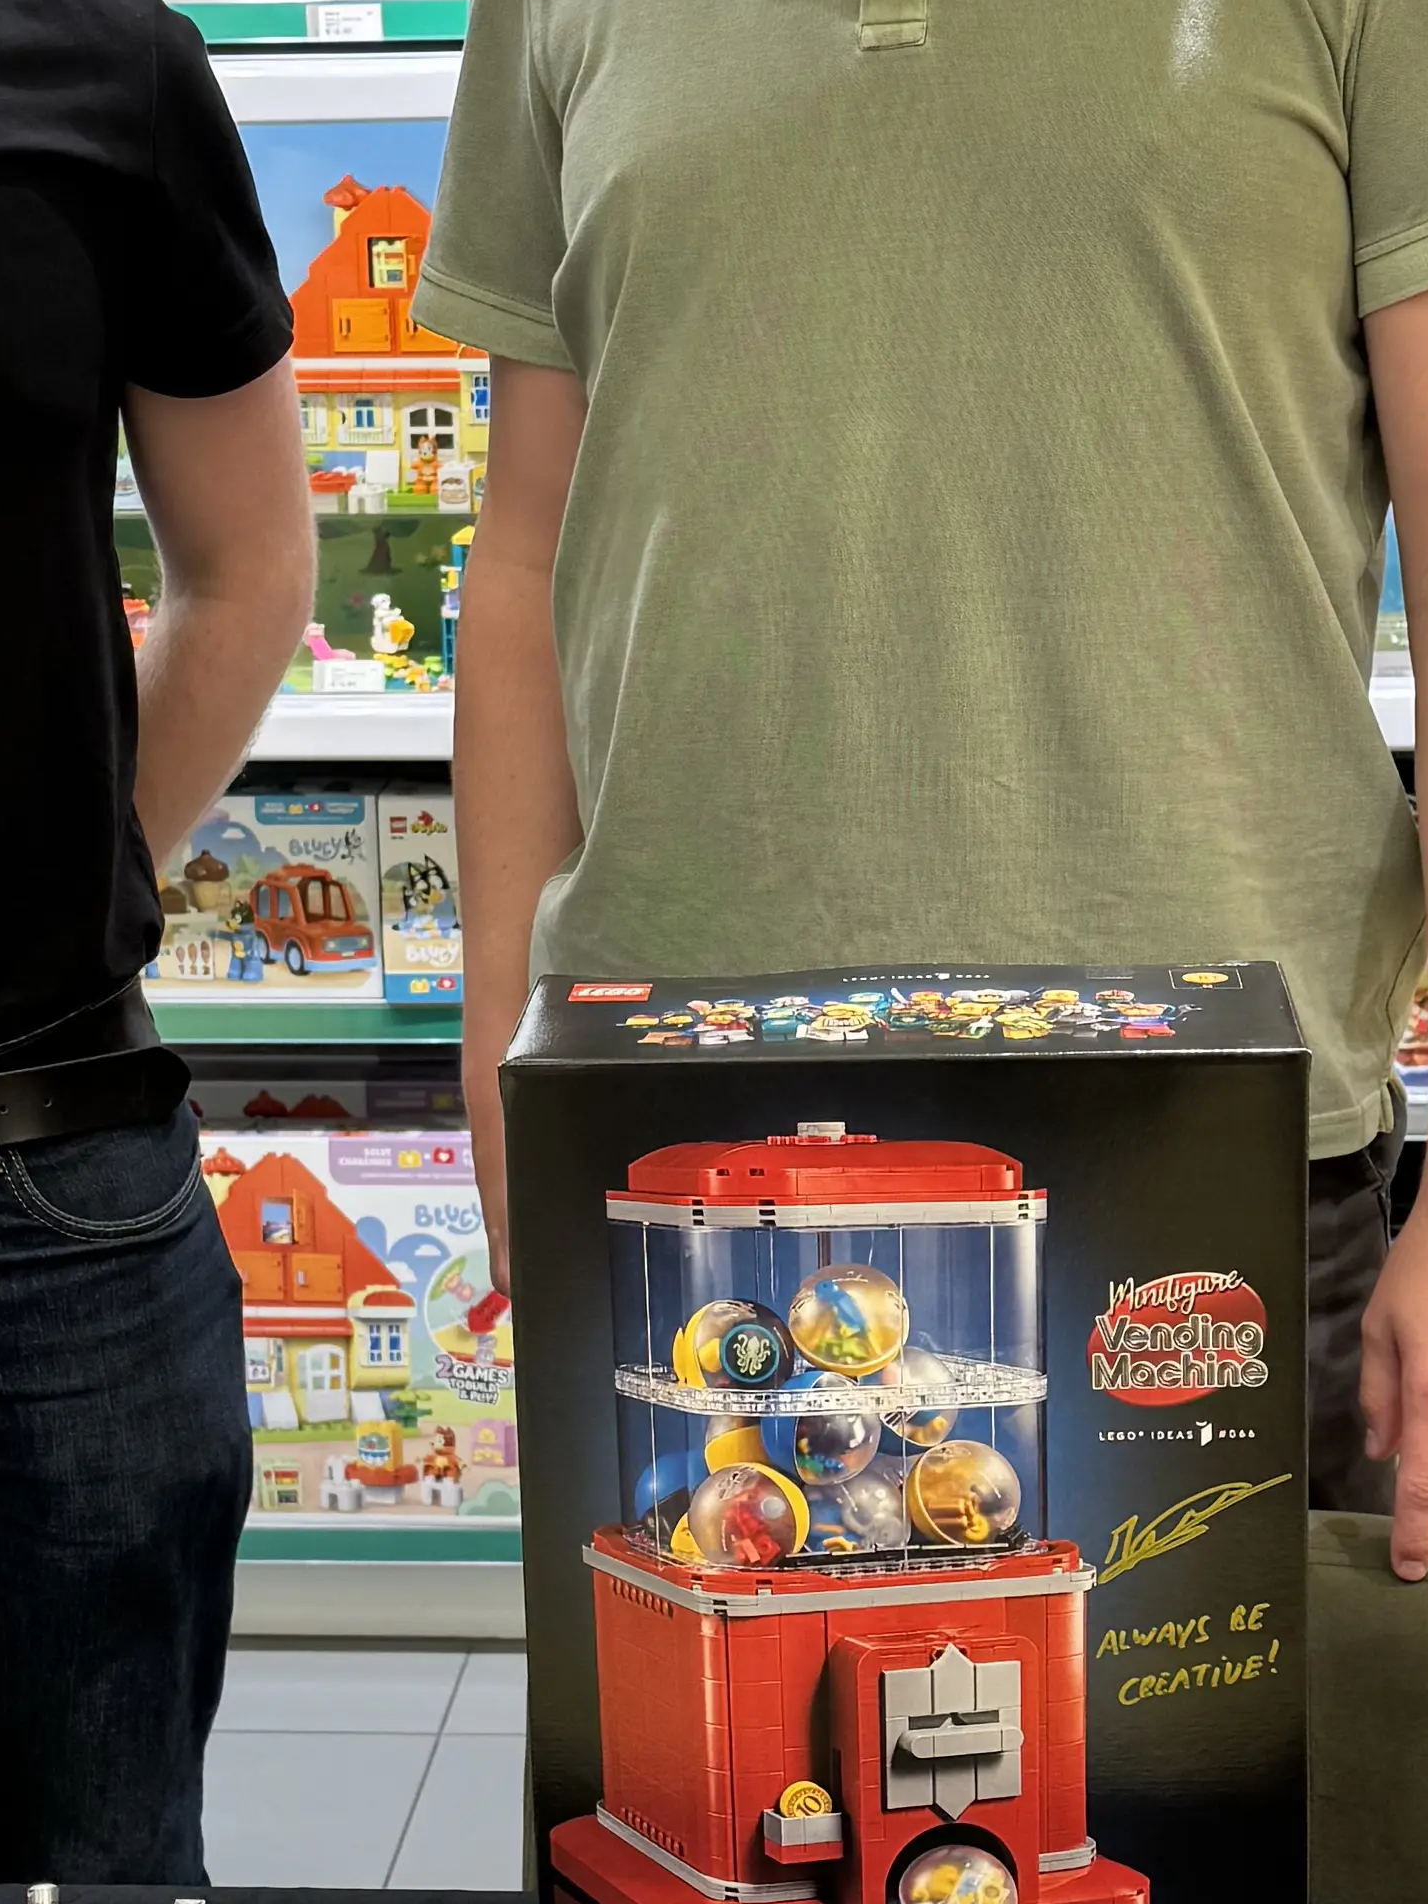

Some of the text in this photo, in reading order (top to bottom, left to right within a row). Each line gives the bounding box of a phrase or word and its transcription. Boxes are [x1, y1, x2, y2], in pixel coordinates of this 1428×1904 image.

[1108, 1269, 1244, 1316] Minifigure
[1096, 1313, 1265, 1359] Vending
[435, 1355, 509, 1384] 2 GAMES
[1091, 1352, 1270, 1391] Machine
[1150, 1429, 1194, 1442] IDEAS
[1218, 1428, 1257, 1441] #066
[1096, 1602, 1270, 1660] ALWAYS BE
[1118, 1639, 1280, 1707] CREATIVE!
[796, 1795, 825, 1815] 10
